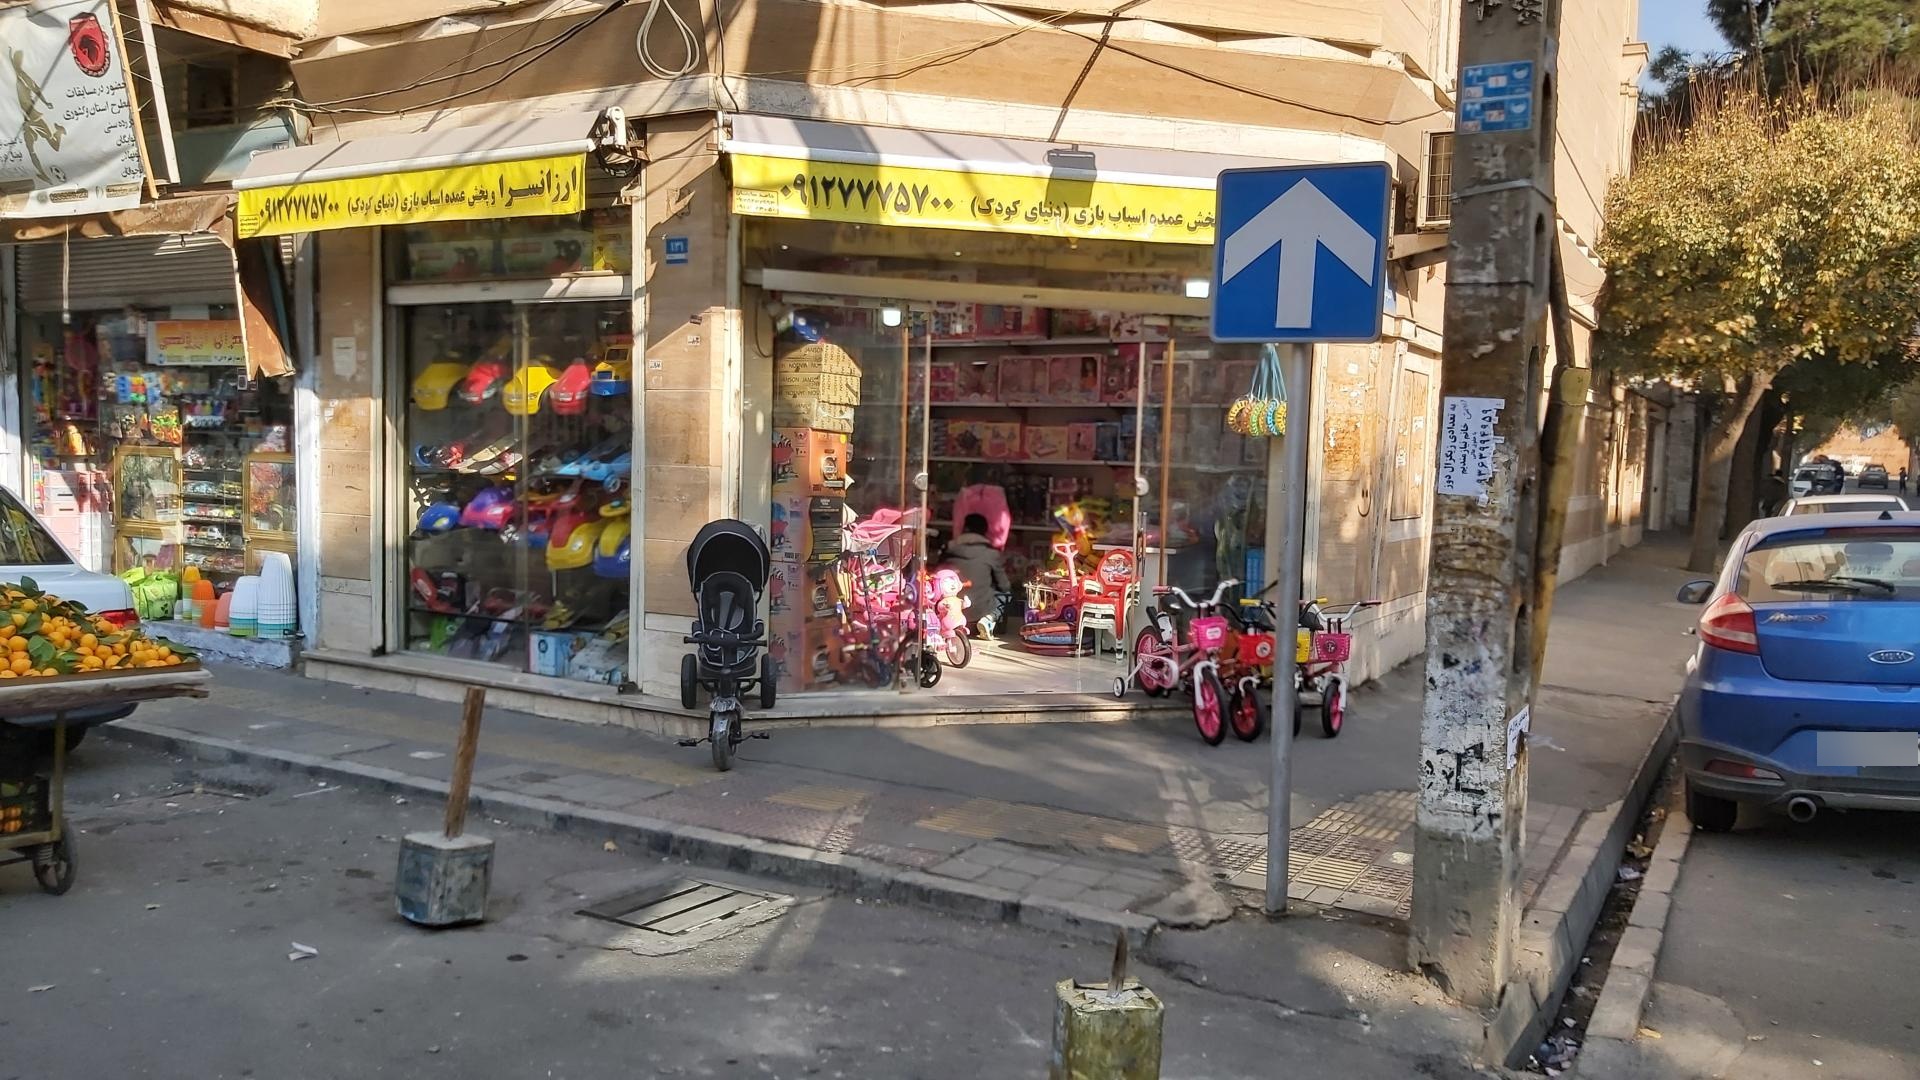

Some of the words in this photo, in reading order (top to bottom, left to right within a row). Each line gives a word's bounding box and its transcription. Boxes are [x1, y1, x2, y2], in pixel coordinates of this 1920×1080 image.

[374, 192, 399, 215] (دنیای
[400, 191, 419, 213] بازی
[421, 189, 443, 210] اسباب
[445, 189, 465, 204] عمده
[468, 184, 489, 208] پخش
[780, 173, 954, 215] ۰۹۱۲۷۷۷۵۷۰۰
[259, 192, 339, 223] ۰۹۱۲۷۷۷۵۷۰۰
[970, 195, 1021, 221] کودک)
[1025, 200, 1070, 224] (دنیای
[1073, 206, 1105, 226] بازی
[1108, 207, 1146, 230] اسباب
[1149, 214, 1183, 227] عمده
[1447, 413, 1457, 443] تعدادی
[1460, 423, 1470, 439] خانم
[1459, 441, 1470, 474] نیازمندیم
[1444, 474, 1454, 489] دوز
